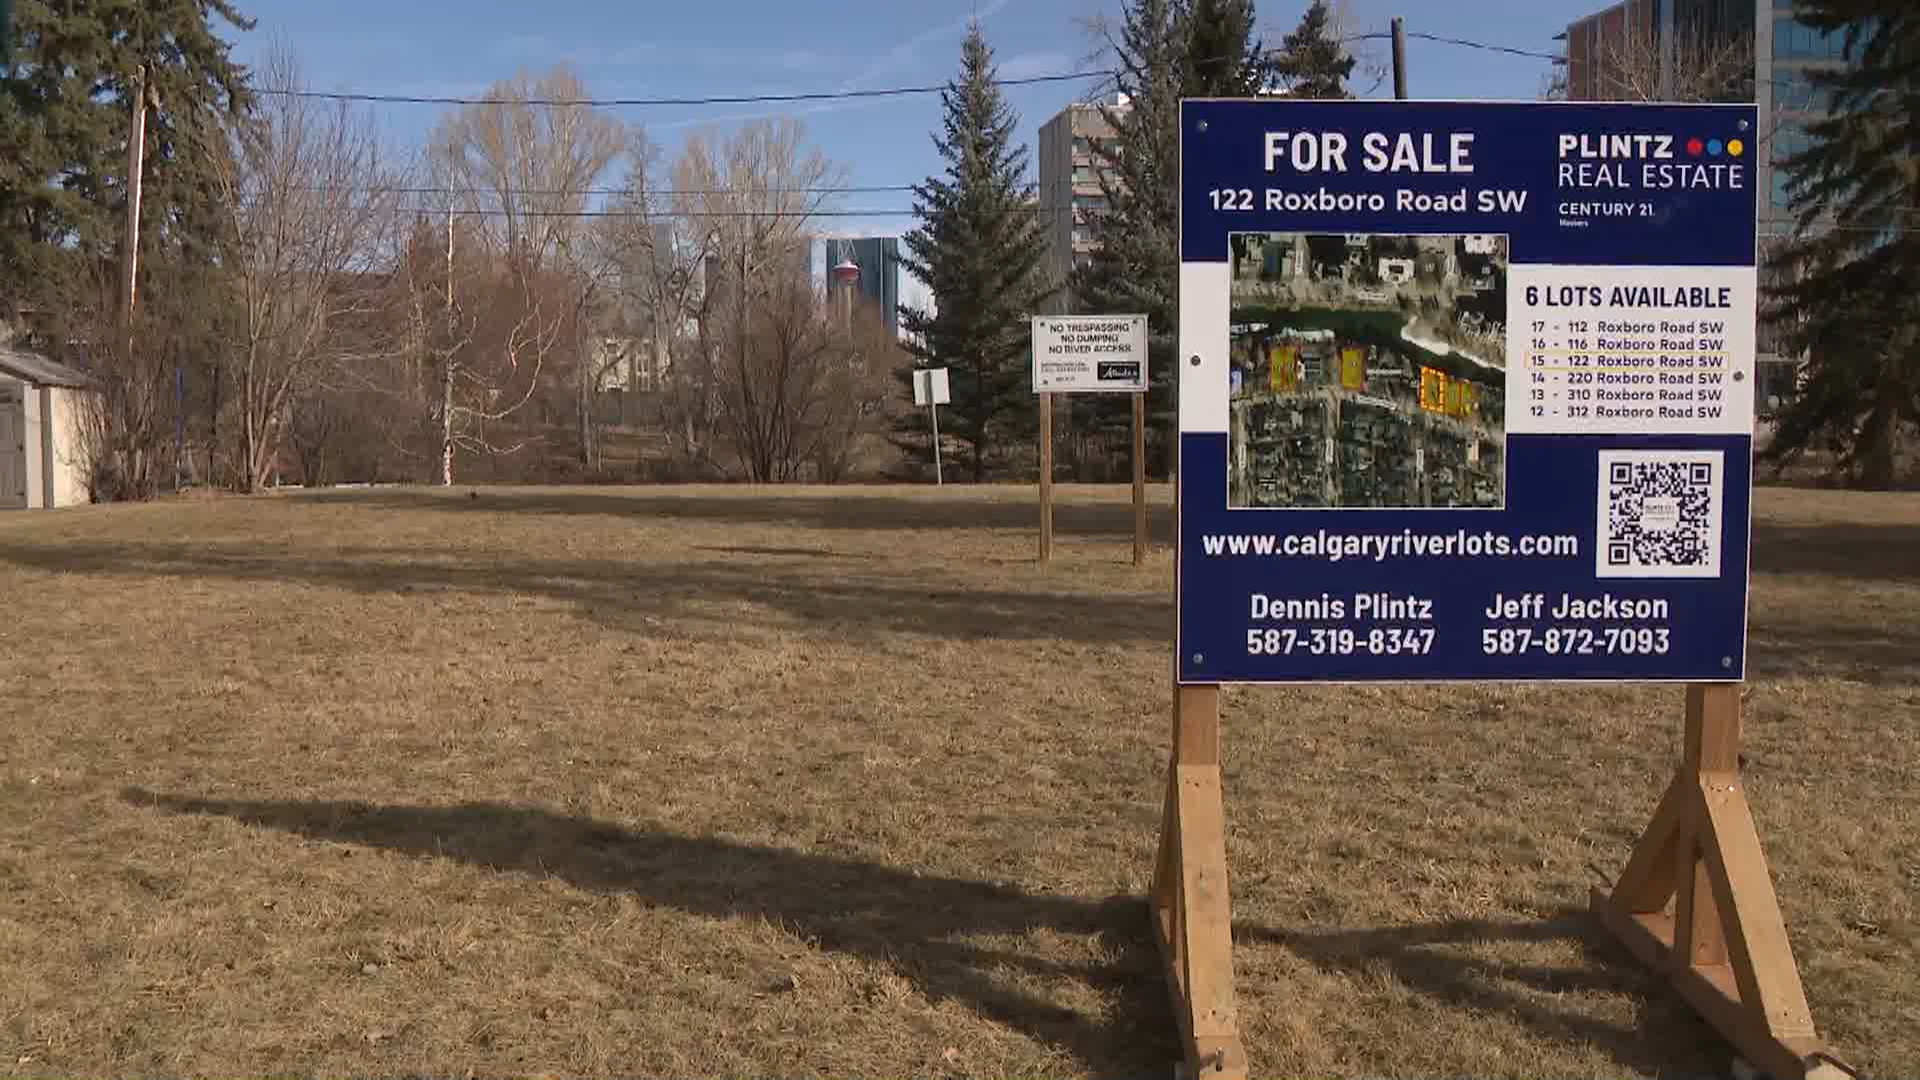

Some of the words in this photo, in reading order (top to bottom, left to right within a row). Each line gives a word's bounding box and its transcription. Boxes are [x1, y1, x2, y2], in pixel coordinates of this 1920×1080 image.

[1264, 132, 1348, 173] FOR
[1362, 132, 1475, 174] SALE
[1558, 134, 1674, 159] PLINTZ
[1558, 163, 1630, 188] REAL
[1642, 164, 1743, 189] ESTATE
[1208, 188, 1255, 212] 122
[1265, 188, 1385, 213] Roxboro
[1396, 188, 1467, 213] Road
[1477, 190, 1528, 214] SW
[1558, 202, 1635, 217] CENTURY
[1526, 286, 1539, 306] 6
[1546, 286, 1602, 307] LOTS
[1610, 287, 1731, 308] AVAILABLE
[1050, 324, 1064, 333] NO
[1067, 323, 1129, 332] TRESPASSING
[1531, 321, 1545, 333] 17
[1568, 321, 1588, 333] 112
[1598, 321, 1655, 334] Roxboro
[1660, 321, 1694, 334] Road
[1699, 321, 1724, 334] SW
[1077, 334, 1119, 342] DUMPING
[1531, 338, 1545, 350] 16
[1568, 338, 1588, 350] 116
[1598, 338, 1655, 351] Roxboro
[1660, 338, 1694, 351] Road
[1699, 338, 1724, 351] SW
[1049, 346, 1063, 354] NO
[1531, 356, 1545, 368] 15
[1568, 356, 1589, 368] 122
[1598, 356, 1655, 368] Roxboro
[1660, 356, 1694, 368] Road
[1699, 356, 1723, 368] SW
[1531, 372, 1545, 384] 14
[1568, 372, 1593, 384] 220
[1597, 372, 1654, 385] Roxboro
[1660, 372, 1694, 385] Road
[1699, 372, 1723, 385] SW
[1531, 389, 1545, 401] 13
[1568, 389, 1590, 401] 310
[1596, 389, 1654, 402] Roxboro
[1659, 389, 1693, 402] Road
[1698, 389, 1722, 402] SW
[1531, 406, 1545, 418] 12
[1568, 406, 1588, 418] 312
[1596, 406, 1654, 419] Roxboro
[1659, 406, 1693, 419] Road
[1698, 406, 1721, 419] SW
[1202, 529, 1579, 562] www.calgaryriverlots.com
[1250, 593, 1346, 619] Dennis
[1354, 594, 1433, 620] Plintz
[1485, 593, 1544, 620] Jeff
[1552, 593, 1669, 619] Jackson
[1246, 628, 1437, 656] 587-319-8347
[1482, 628, 1671, 656] 587-872-7093
